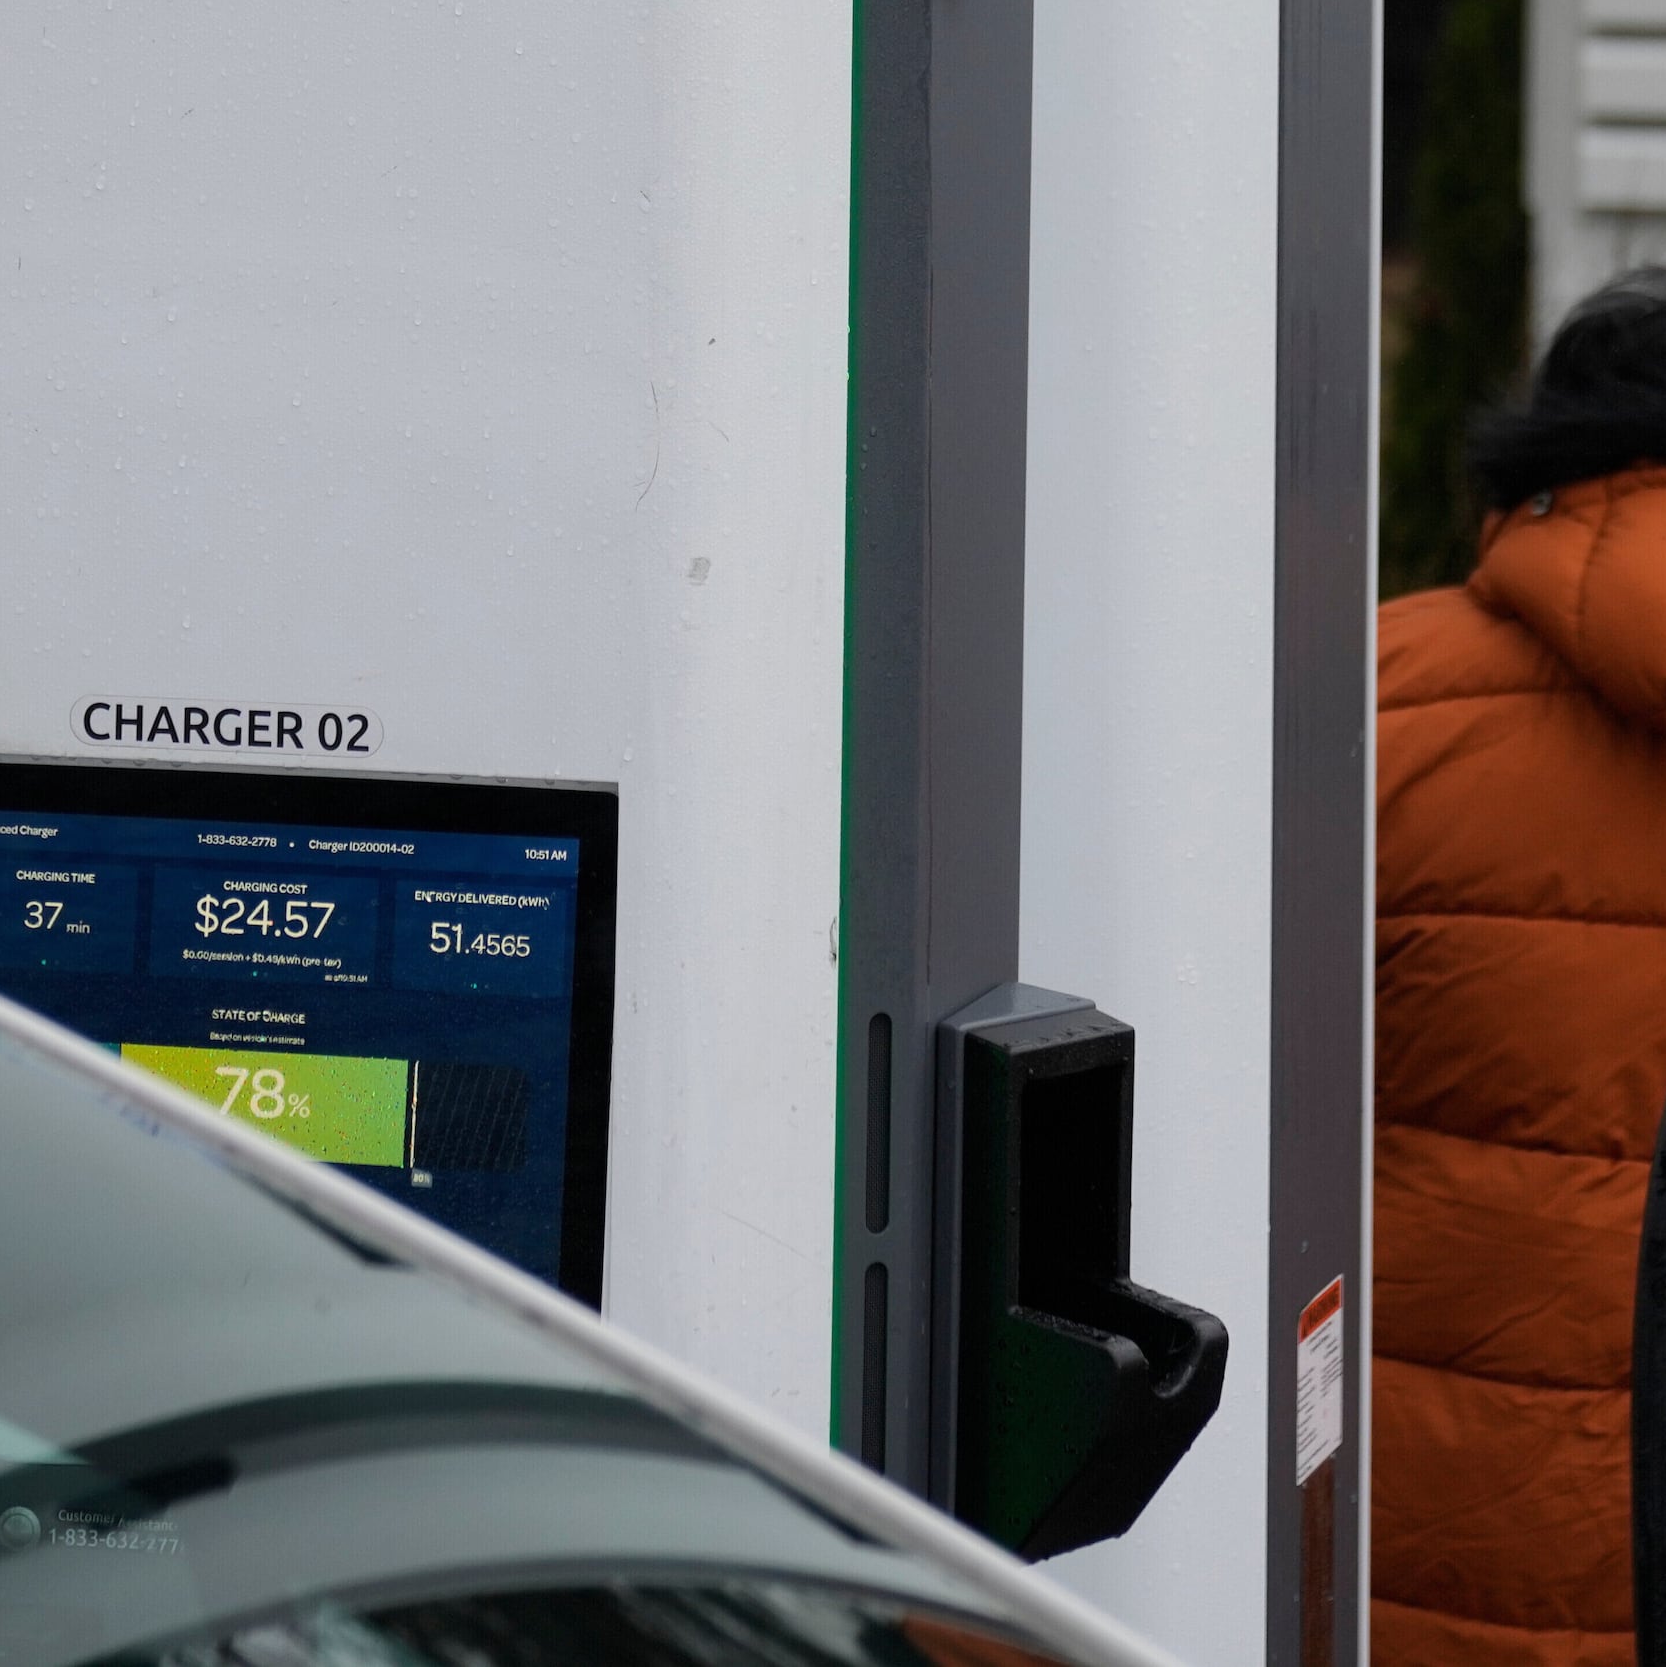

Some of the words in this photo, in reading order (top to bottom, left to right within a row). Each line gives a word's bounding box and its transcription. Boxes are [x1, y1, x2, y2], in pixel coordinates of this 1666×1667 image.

[83, 702, 303, 749] CHARGER
[318, 712, 369, 752] 02
[19, 825, 58, 839] Charger
[197, 834, 277, 847] 1-833-632-2778
[308, 839, 347, 853] Charger
[525, 849, 549, 860] 10:51
[551, 850, 567, 861] AM
[16, 870, 70, 883] CHARGING
[71, 872, 96, 884] TIME
[223, 881, 278, 893] CHARGING
[279, 884, 308, 895] COST
[458, 892, 517, 906] DELIVERED
[23, 900, 64, 930] 37
[66, 920, 91, 934] min
[194, 894, 335, 938] $24.57
[429, 921, 531, 958] 51.4565
[211, 1009, 245, 1021] STATE
[246, 1011, 262, 1022] OF
[262, 1010, 306, 1025] CHARGE
[214, 1065, 311, 1120] 78%
[49, 1528, 183, 1554] 1-833-632-277
